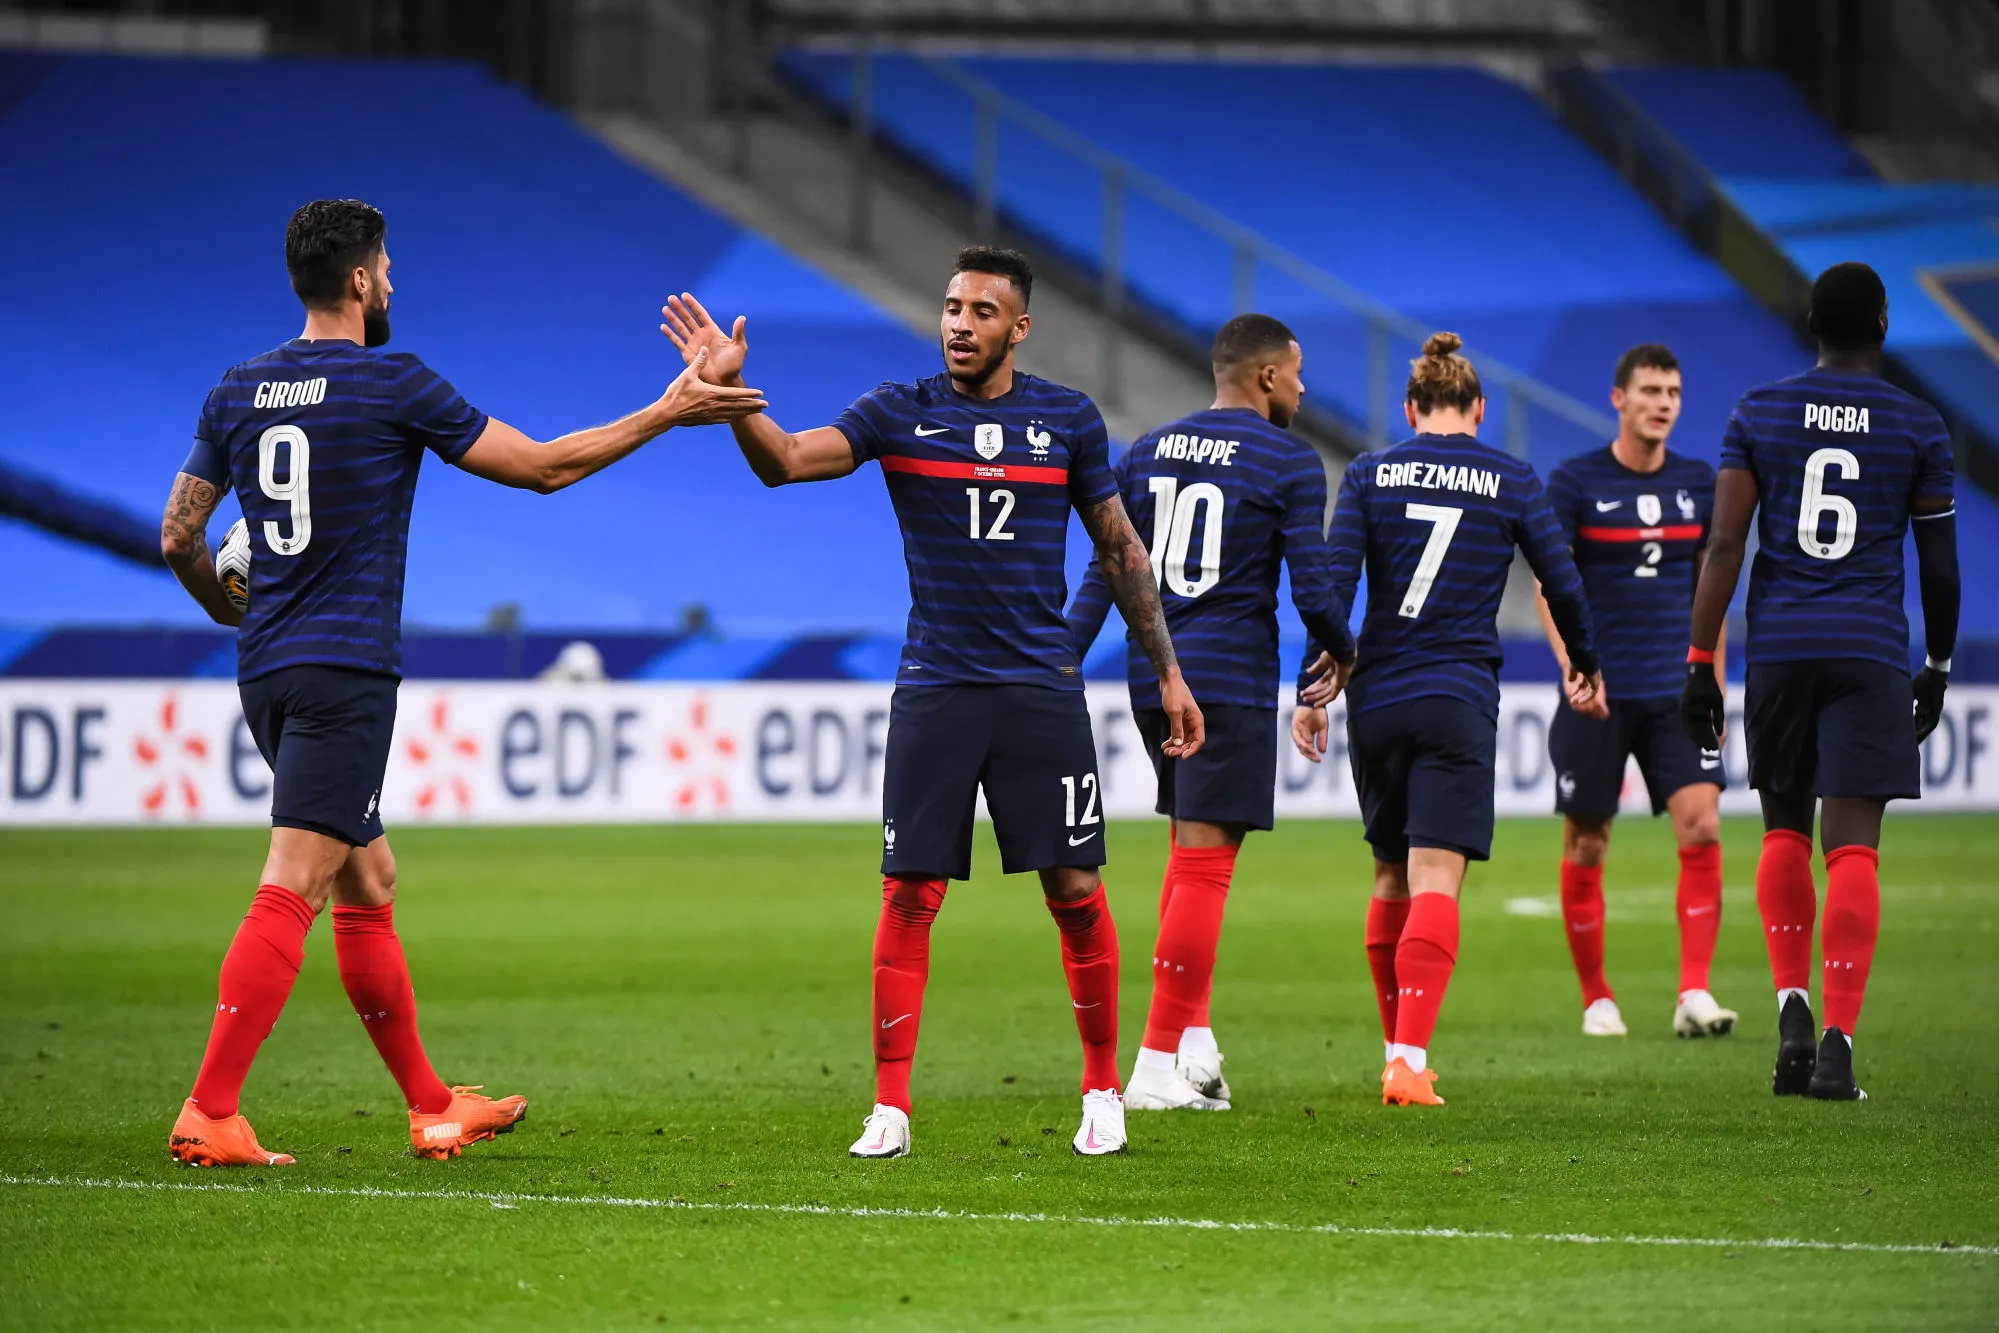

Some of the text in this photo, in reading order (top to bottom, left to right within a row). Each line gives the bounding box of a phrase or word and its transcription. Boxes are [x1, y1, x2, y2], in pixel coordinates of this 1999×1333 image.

[254, 377, 327, 408] GIROUD
[1804, 403, 1869, 433] POGBA
[1154, 433, 1240, 467] MBAPPE
[258, 424, 312, 555] 9
[1375, 461, 1501, 499] GRIEZMANN
[1798, 447, 1860, 560] 6
[966, 487, 1016, 541] 12
[1148, 476, 1225, 598] 10
[1398, 503, 1464, 619] 7
[1633, 541, 1663, 578] 2
[0, 707, 106, 803] DF
[1061, 772, 1100, 827] 12
